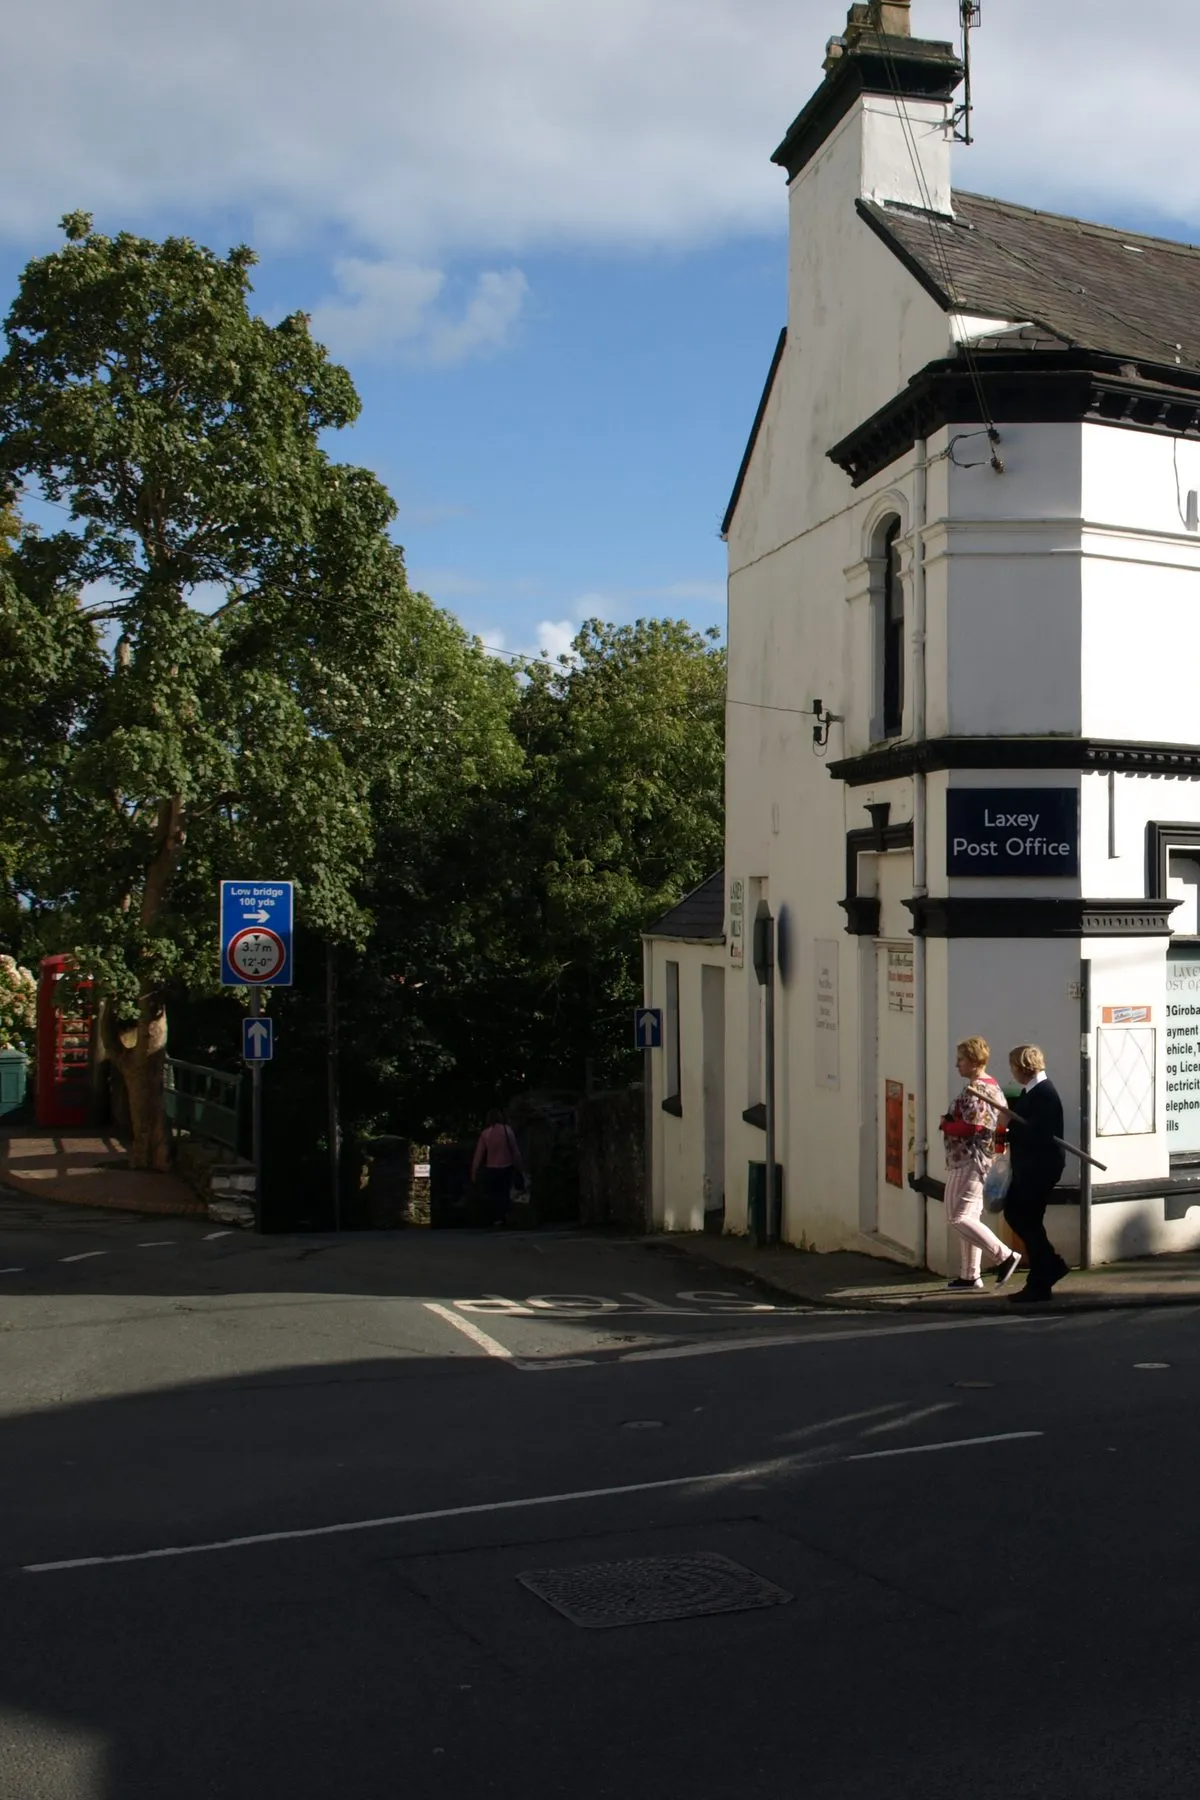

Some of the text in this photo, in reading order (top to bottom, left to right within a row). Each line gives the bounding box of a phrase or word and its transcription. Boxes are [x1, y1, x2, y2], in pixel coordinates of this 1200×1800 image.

[984, 808, 1040, 832] Laxey
[953, 837, 1071, 856] Post Office
[230, 887, 284, 897] Low bridge
[240, 898, 275, 908] 100 yds
[1166, 979, 1185, 991] OST
[1166, 1025, 1199, 1039] ayment
[1166, 1065, 1178, 1076] og
[1166, 1119, 1180, 1132] ills
